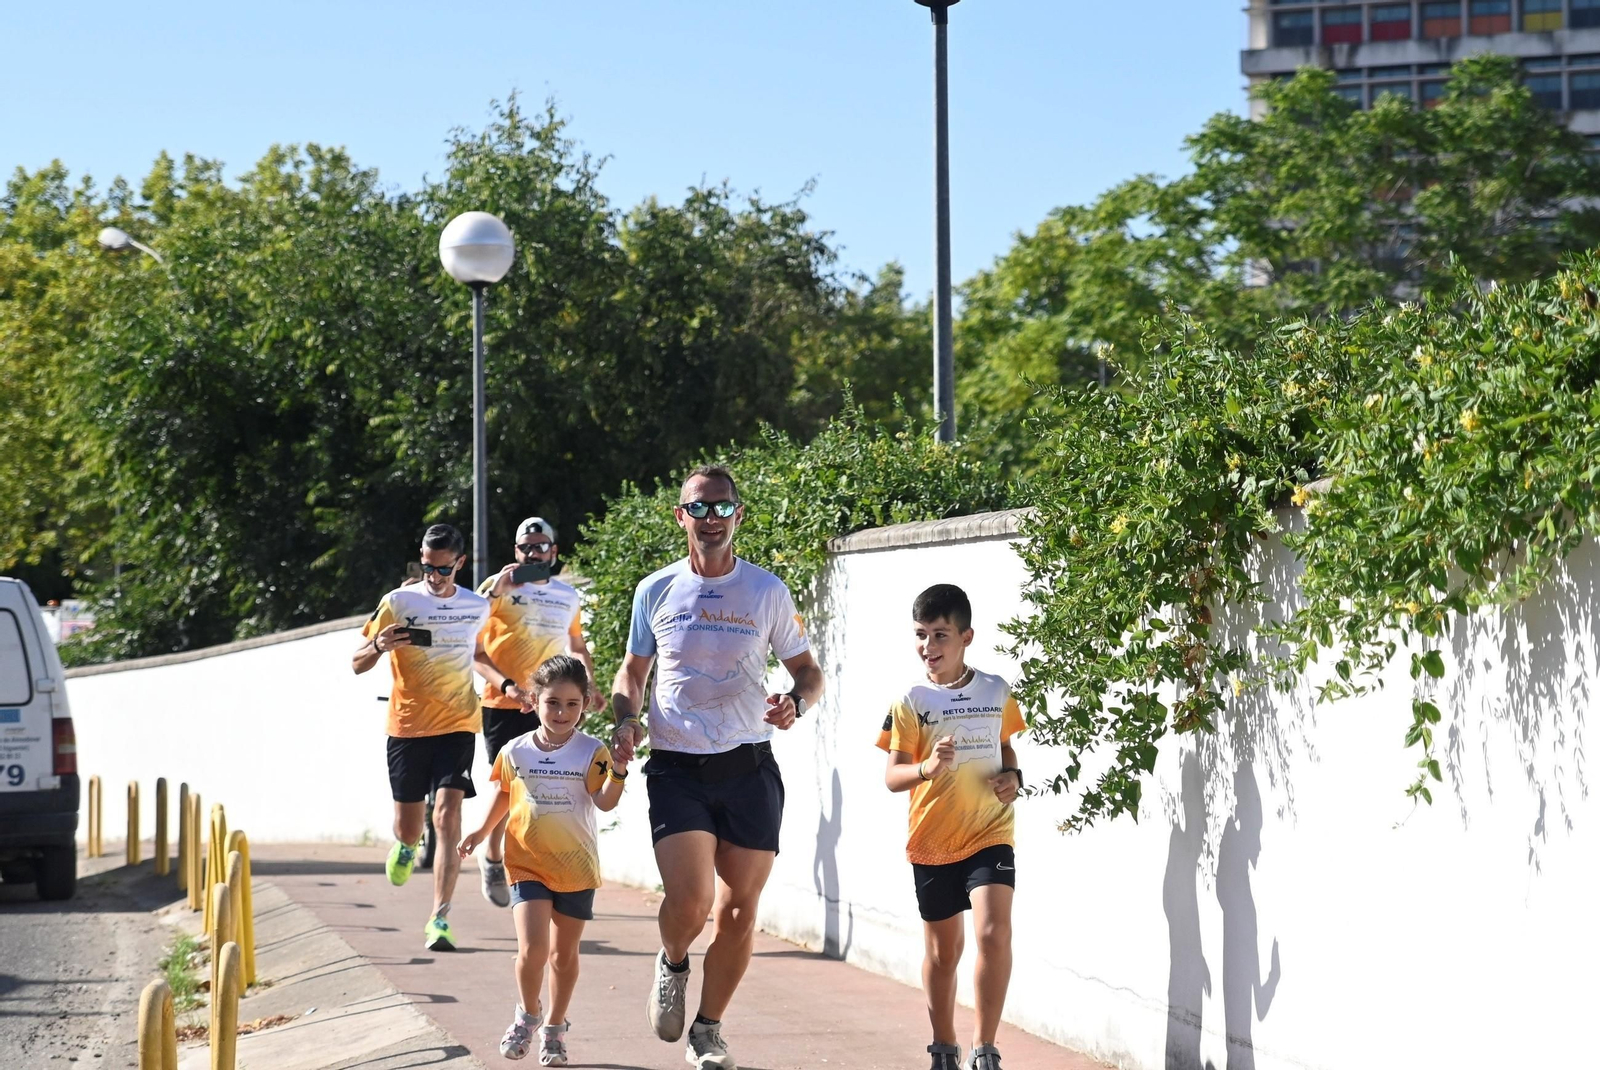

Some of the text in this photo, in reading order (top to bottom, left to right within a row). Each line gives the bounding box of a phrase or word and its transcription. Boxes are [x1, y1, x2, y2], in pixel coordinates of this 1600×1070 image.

[699, 607, 758, 629] Andalucía
[687, 624, 725, 633] SONRISA
[726, 625, 761, 638] INFANTIL
